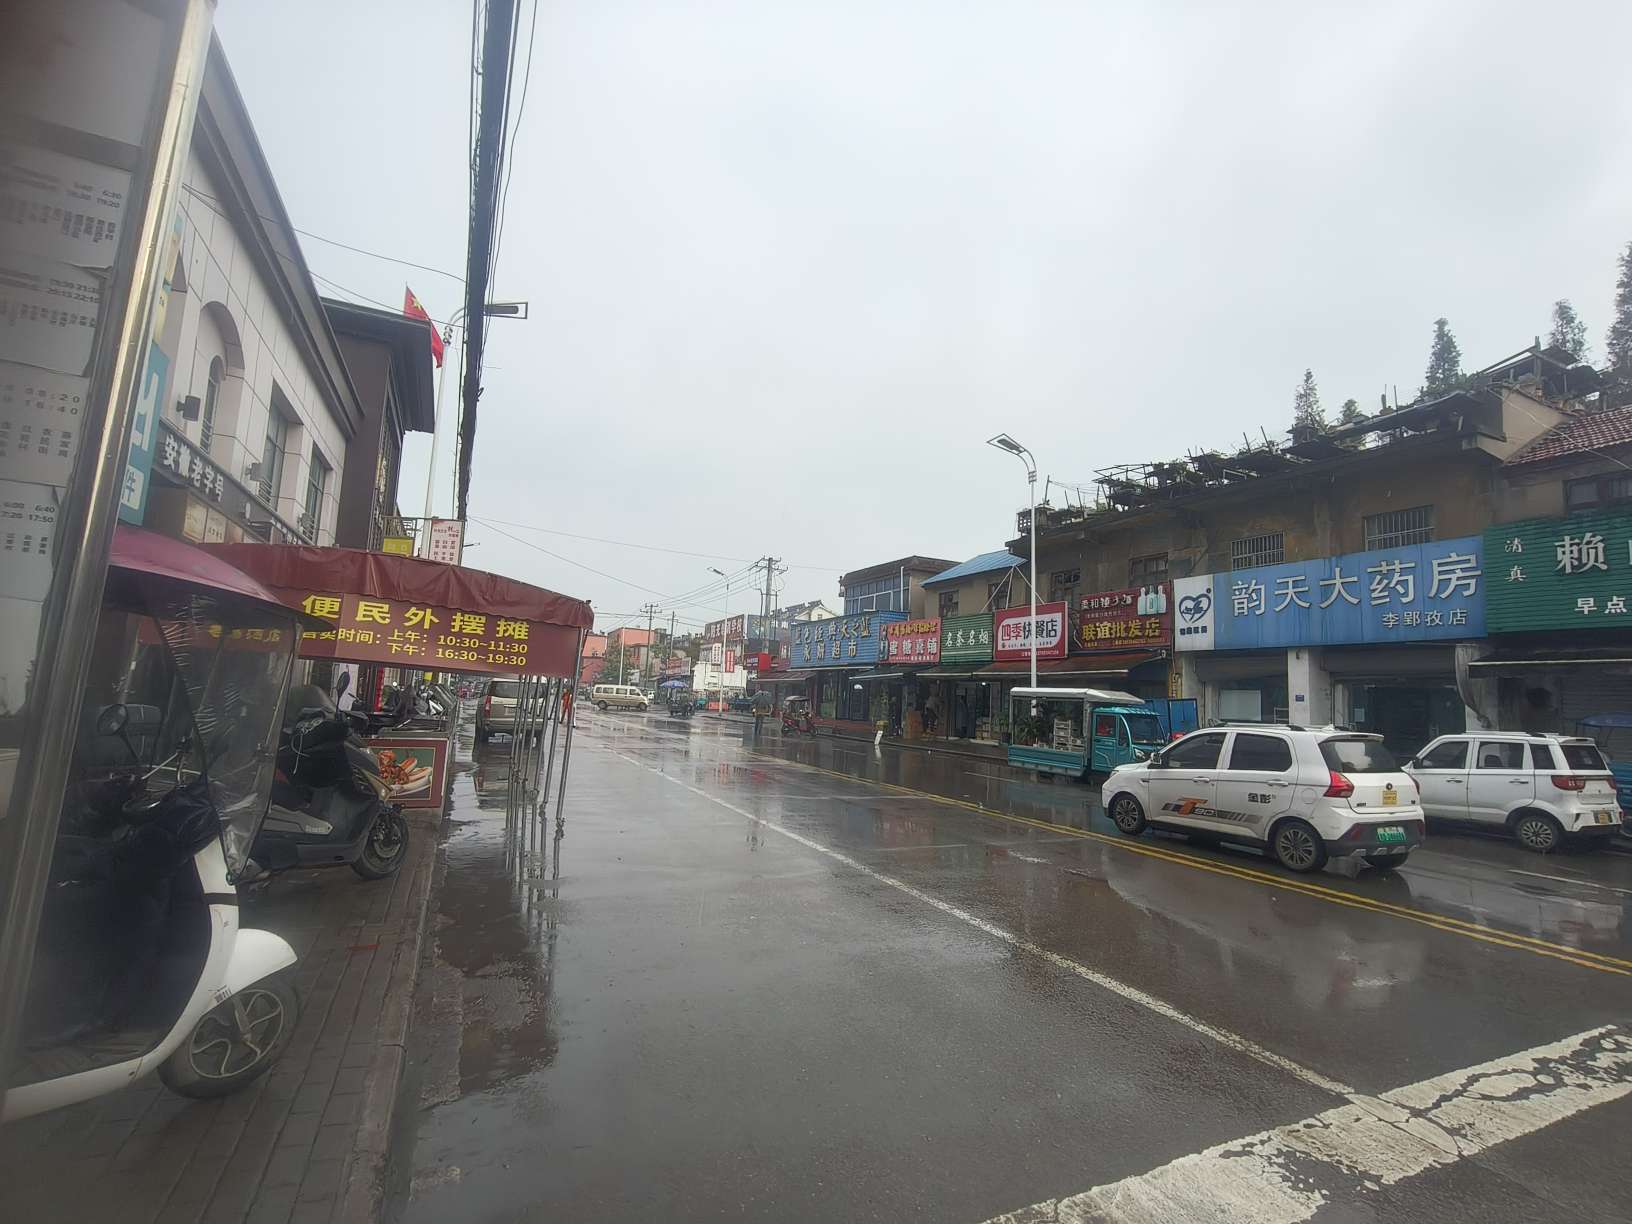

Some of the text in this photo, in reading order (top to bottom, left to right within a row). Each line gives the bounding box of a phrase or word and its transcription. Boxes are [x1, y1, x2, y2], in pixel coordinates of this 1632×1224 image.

[1231, 552, 1482, 617] 韵天大药房
[1574, 596, 1628, 615] 早点
[302, 594, 530, 641] 便民外摆摊
[1381, 608, 1468, 628] 李郢孜店
[437, 635, 529, 654] 10:30~11:30
[435, 648, 527, 667] 16:30~19:30
